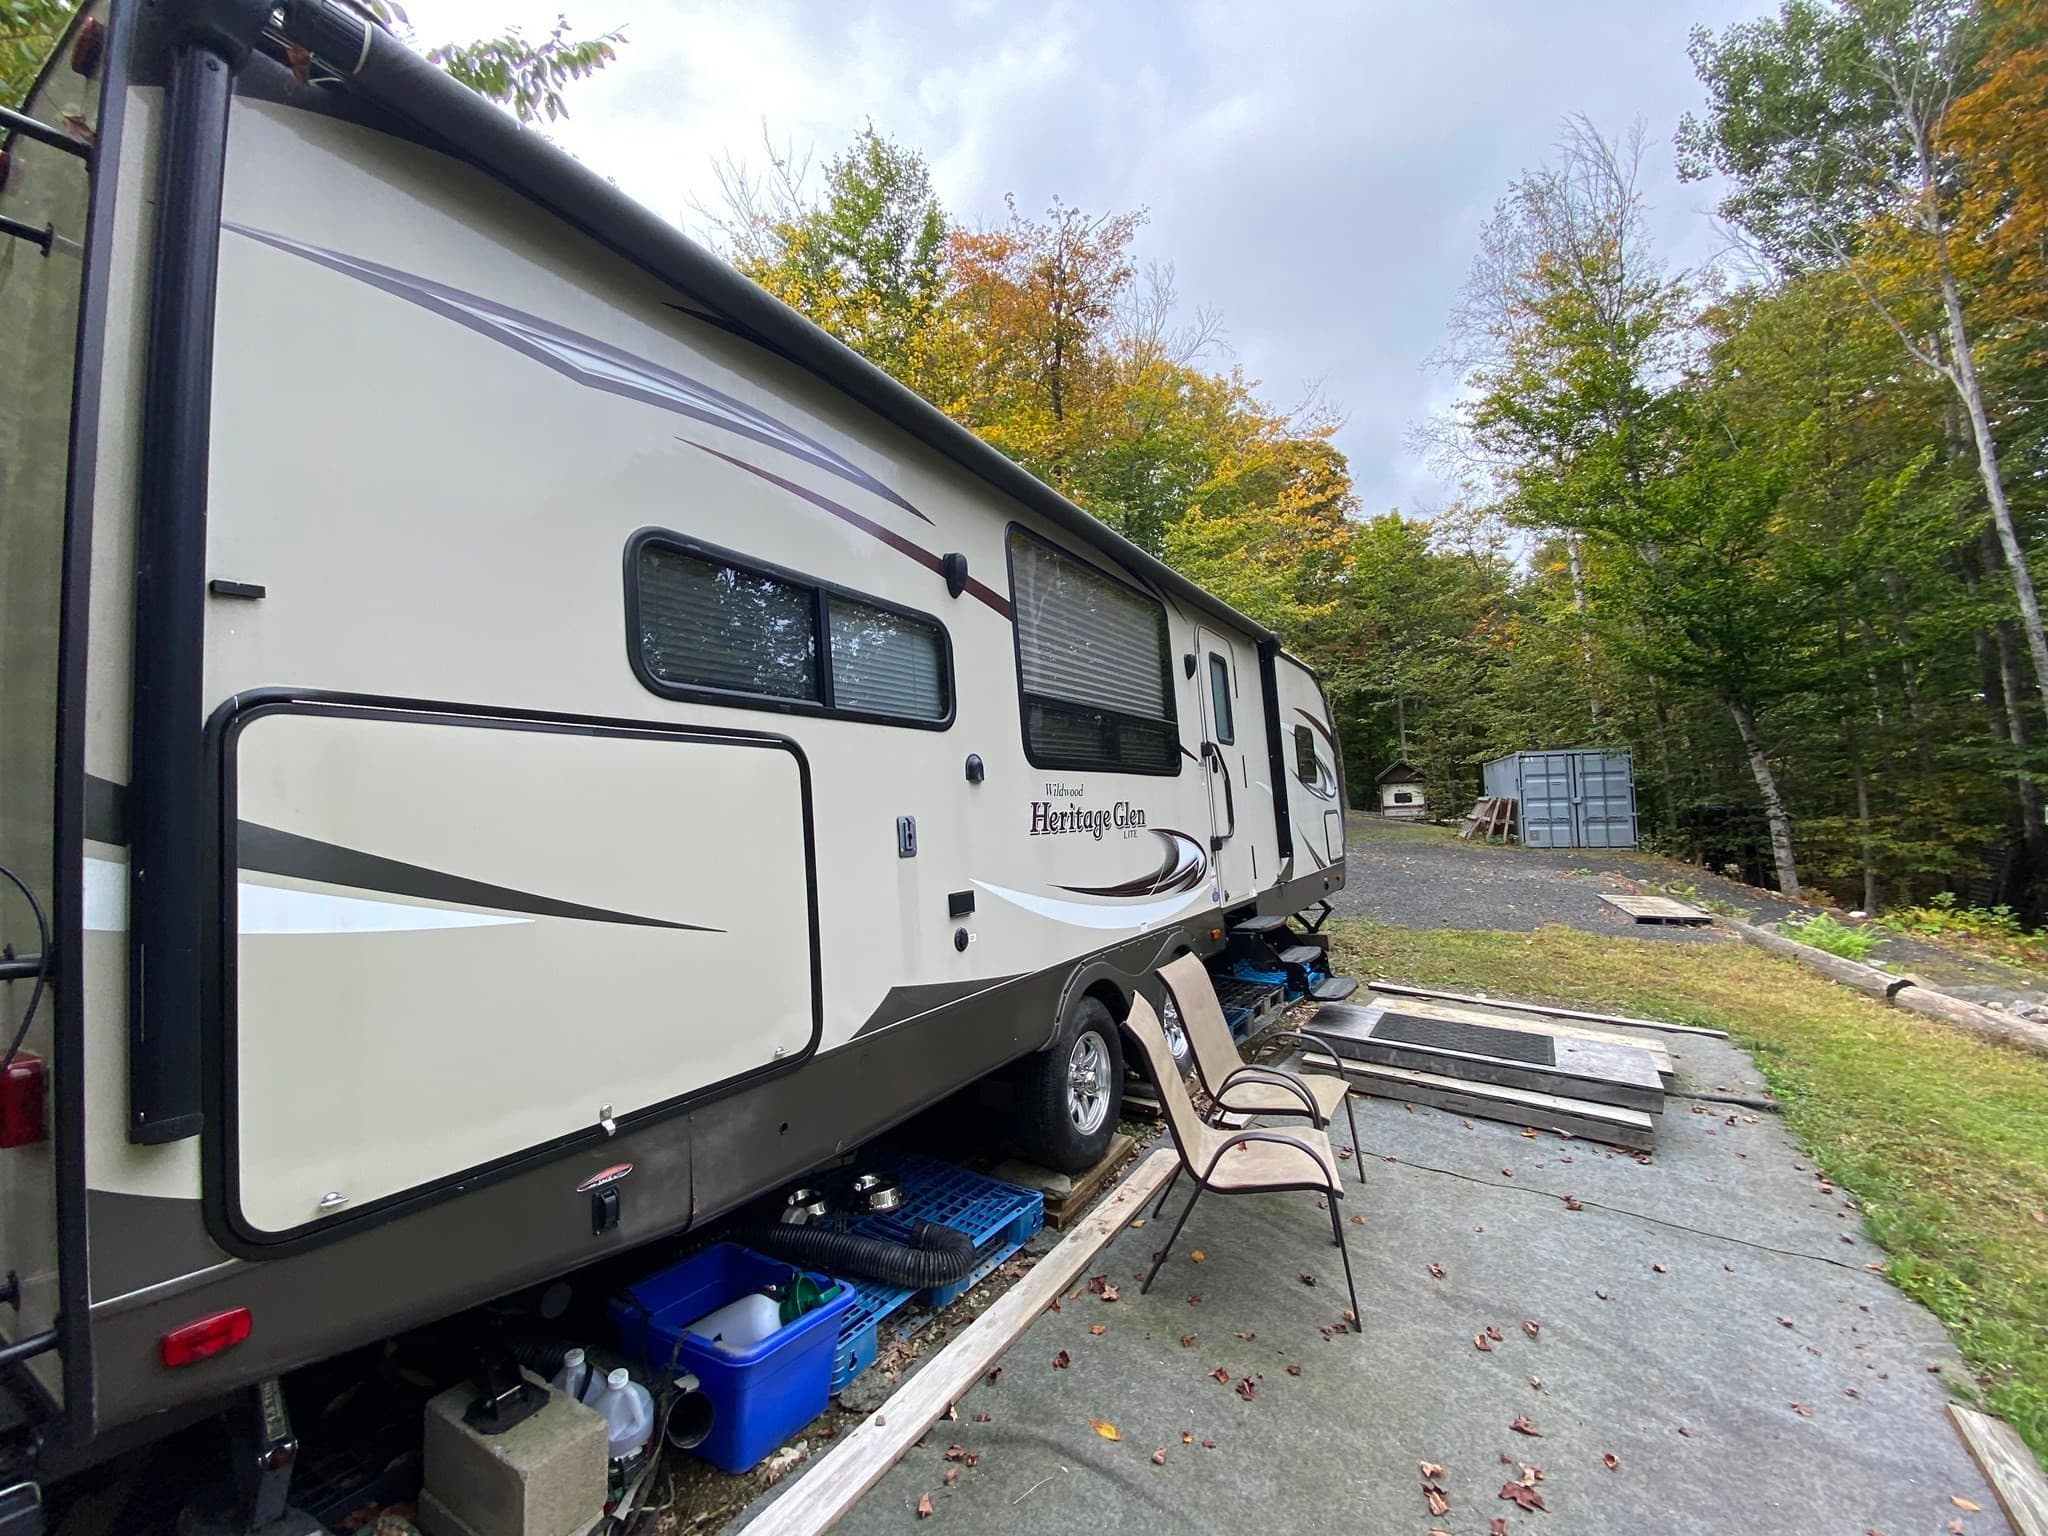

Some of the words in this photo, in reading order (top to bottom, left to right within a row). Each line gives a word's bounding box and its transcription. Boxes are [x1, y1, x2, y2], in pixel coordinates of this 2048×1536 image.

[1045, 783, 1084, 797] Wildwood
[1029, 801, 1112, 841] Heritage
[1113, 801, 1146, 829] Glen
[1123, 830, 1138, 840] LITE
